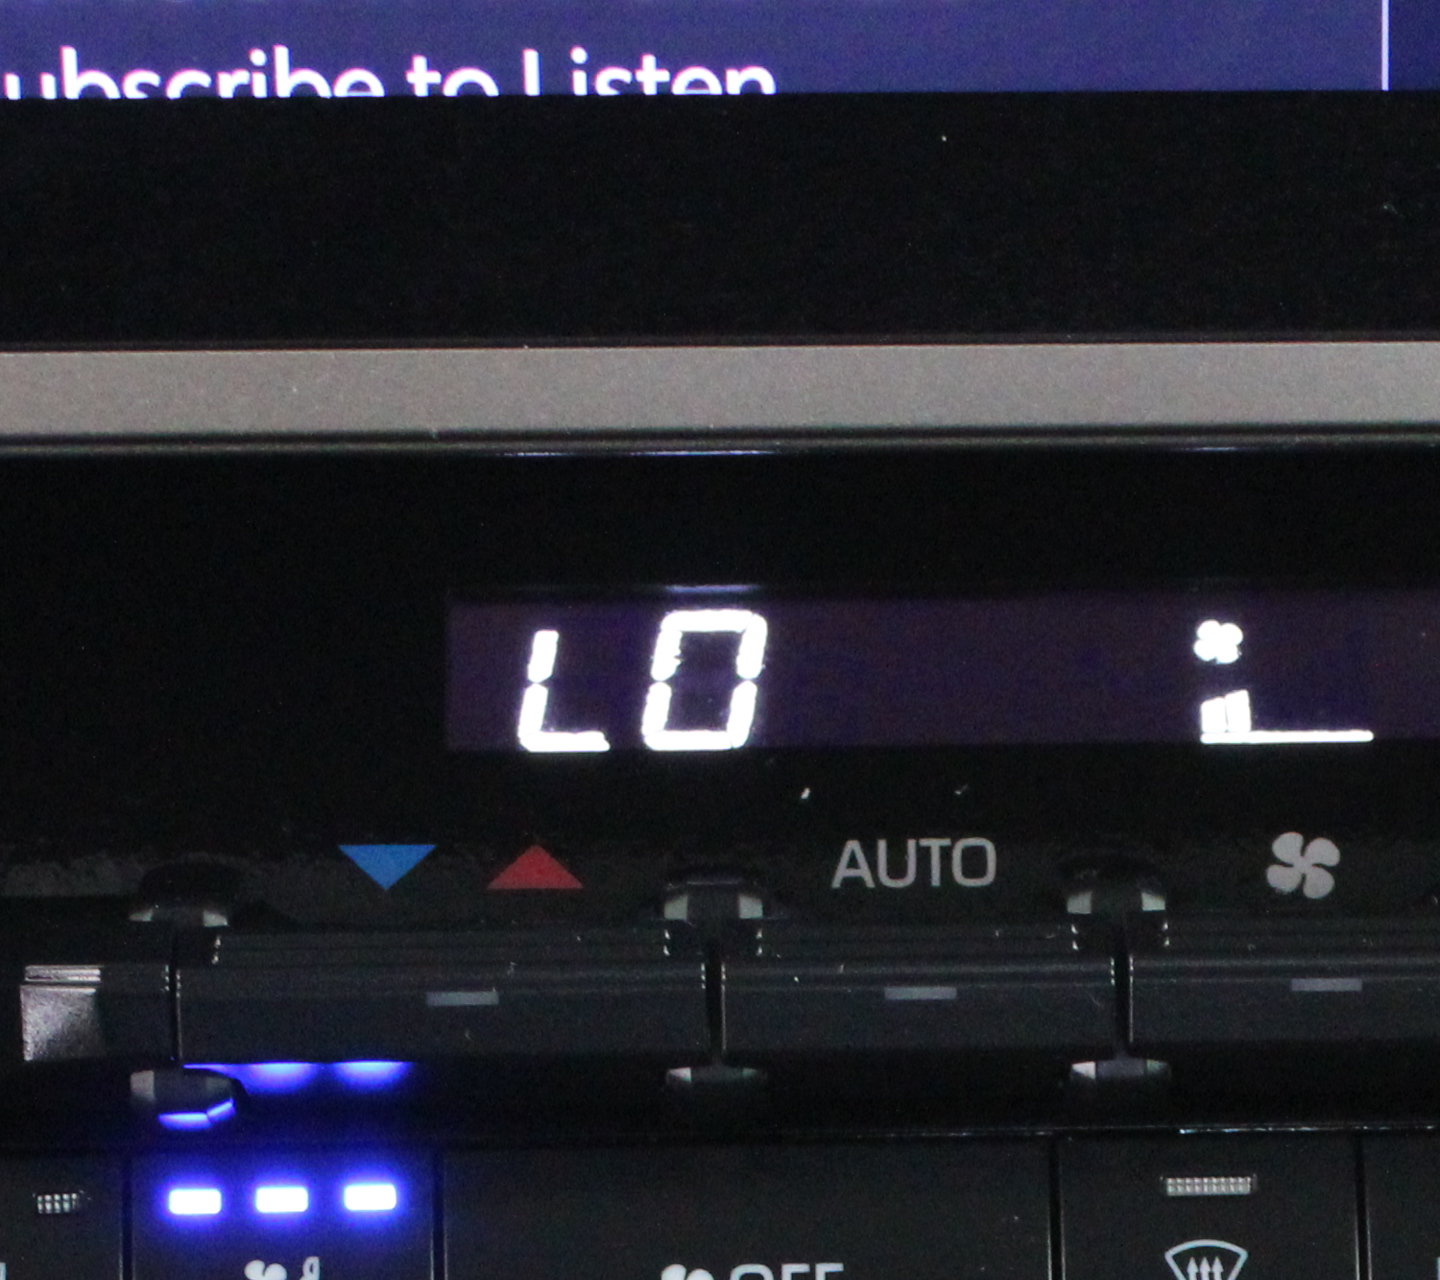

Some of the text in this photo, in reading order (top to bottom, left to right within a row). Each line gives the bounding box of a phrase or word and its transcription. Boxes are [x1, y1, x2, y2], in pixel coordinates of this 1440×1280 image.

[406, 55, 498, 96] to
[517, 608, 768, 753] LO
[832, 837, 996, 888] AUTO
